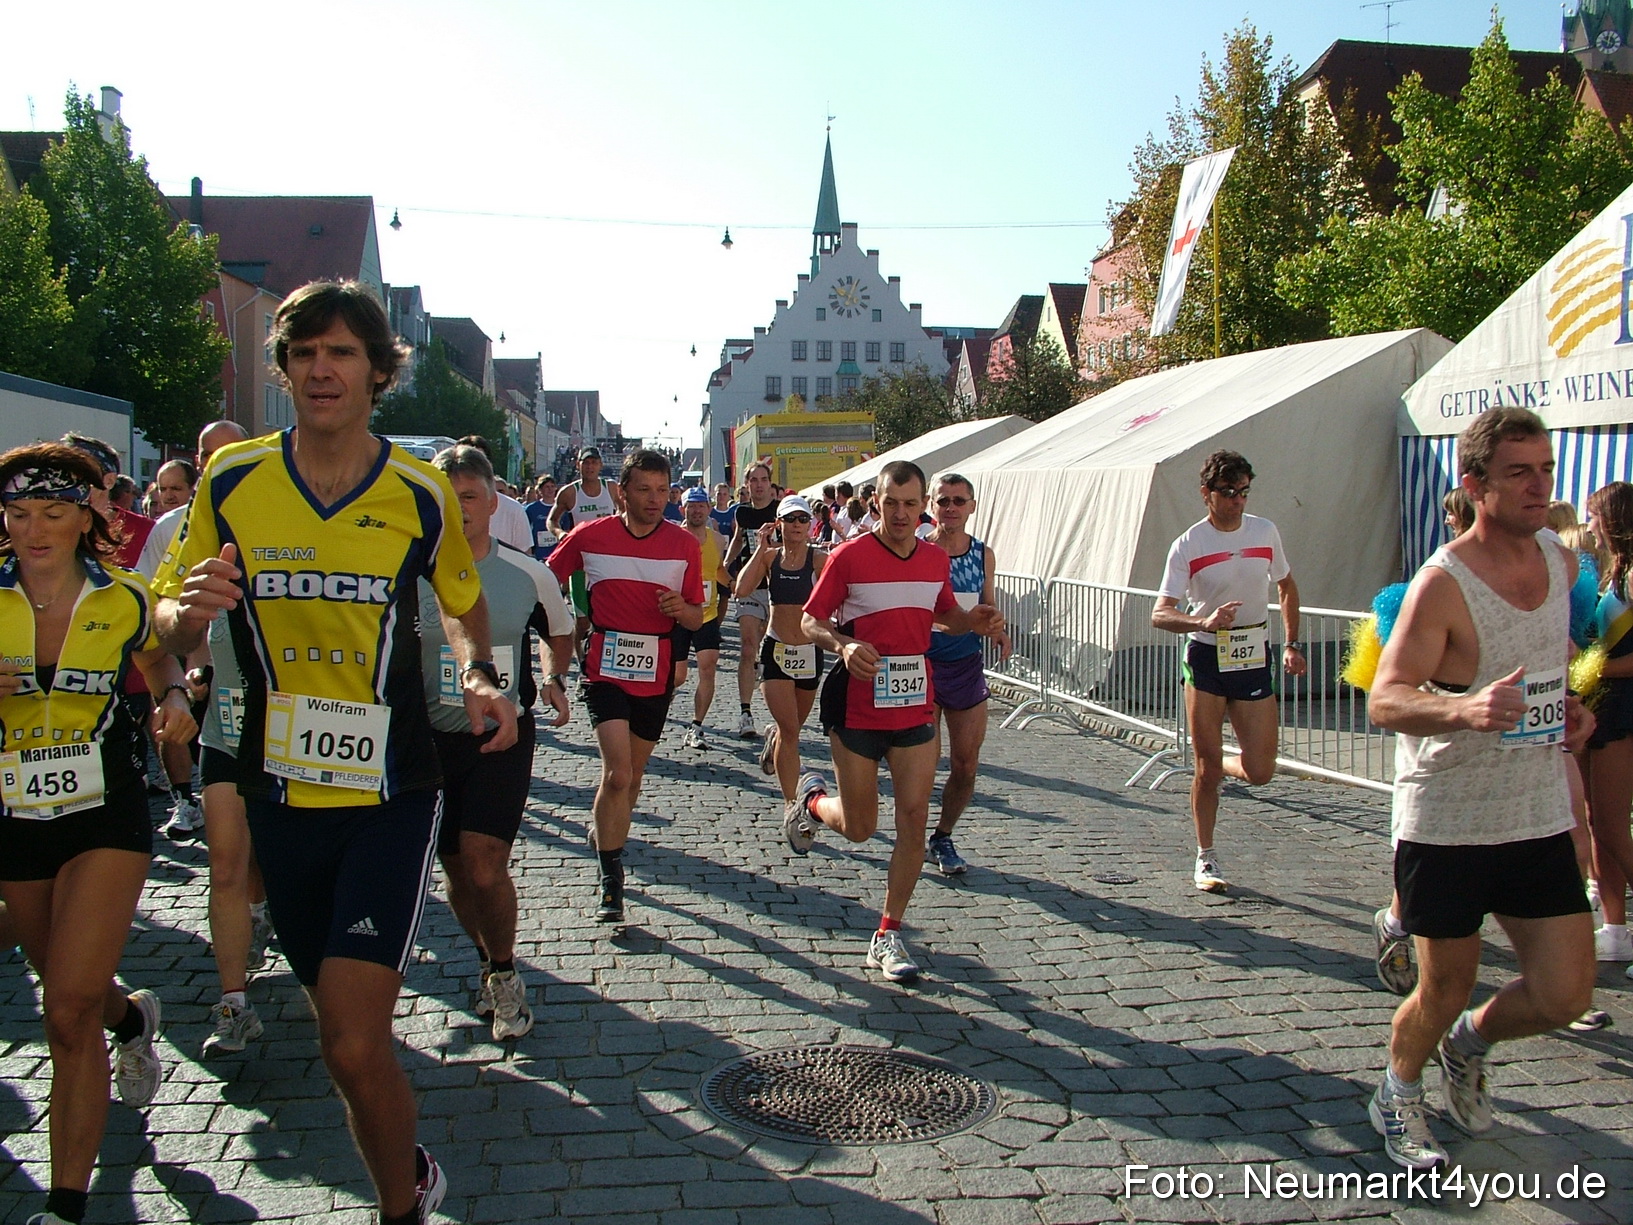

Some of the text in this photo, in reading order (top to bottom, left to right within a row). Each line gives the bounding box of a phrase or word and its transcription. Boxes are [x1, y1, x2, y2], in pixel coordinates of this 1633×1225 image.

[252, 547, 315, 561] TEAM
[252, 570, 392, 604] BOCK
[617, 637, 646, 650] Günter
[1229, 634, 1248, 643] Peter
[605, 648, 612, 657] B
[1230, 645, 1255, 660] 487
[616, 653, 655, 669] 2979
[784, 658, 806, 670] 822
[889, 661, 920, 672] Manfred
[444, 668, 453, 678] B
[877, 675, 885, 685] B
[891, 676, 925, 694] 3347
[307, 697, 367, 717] Wolfram
[20, 741, 91, 763] Marianne
[299, 729, 375, 762] 1050
[4, 772, 16, 786] B
[26, 768, 79, 798] 458
[347, 927, 379, 936] adidas
